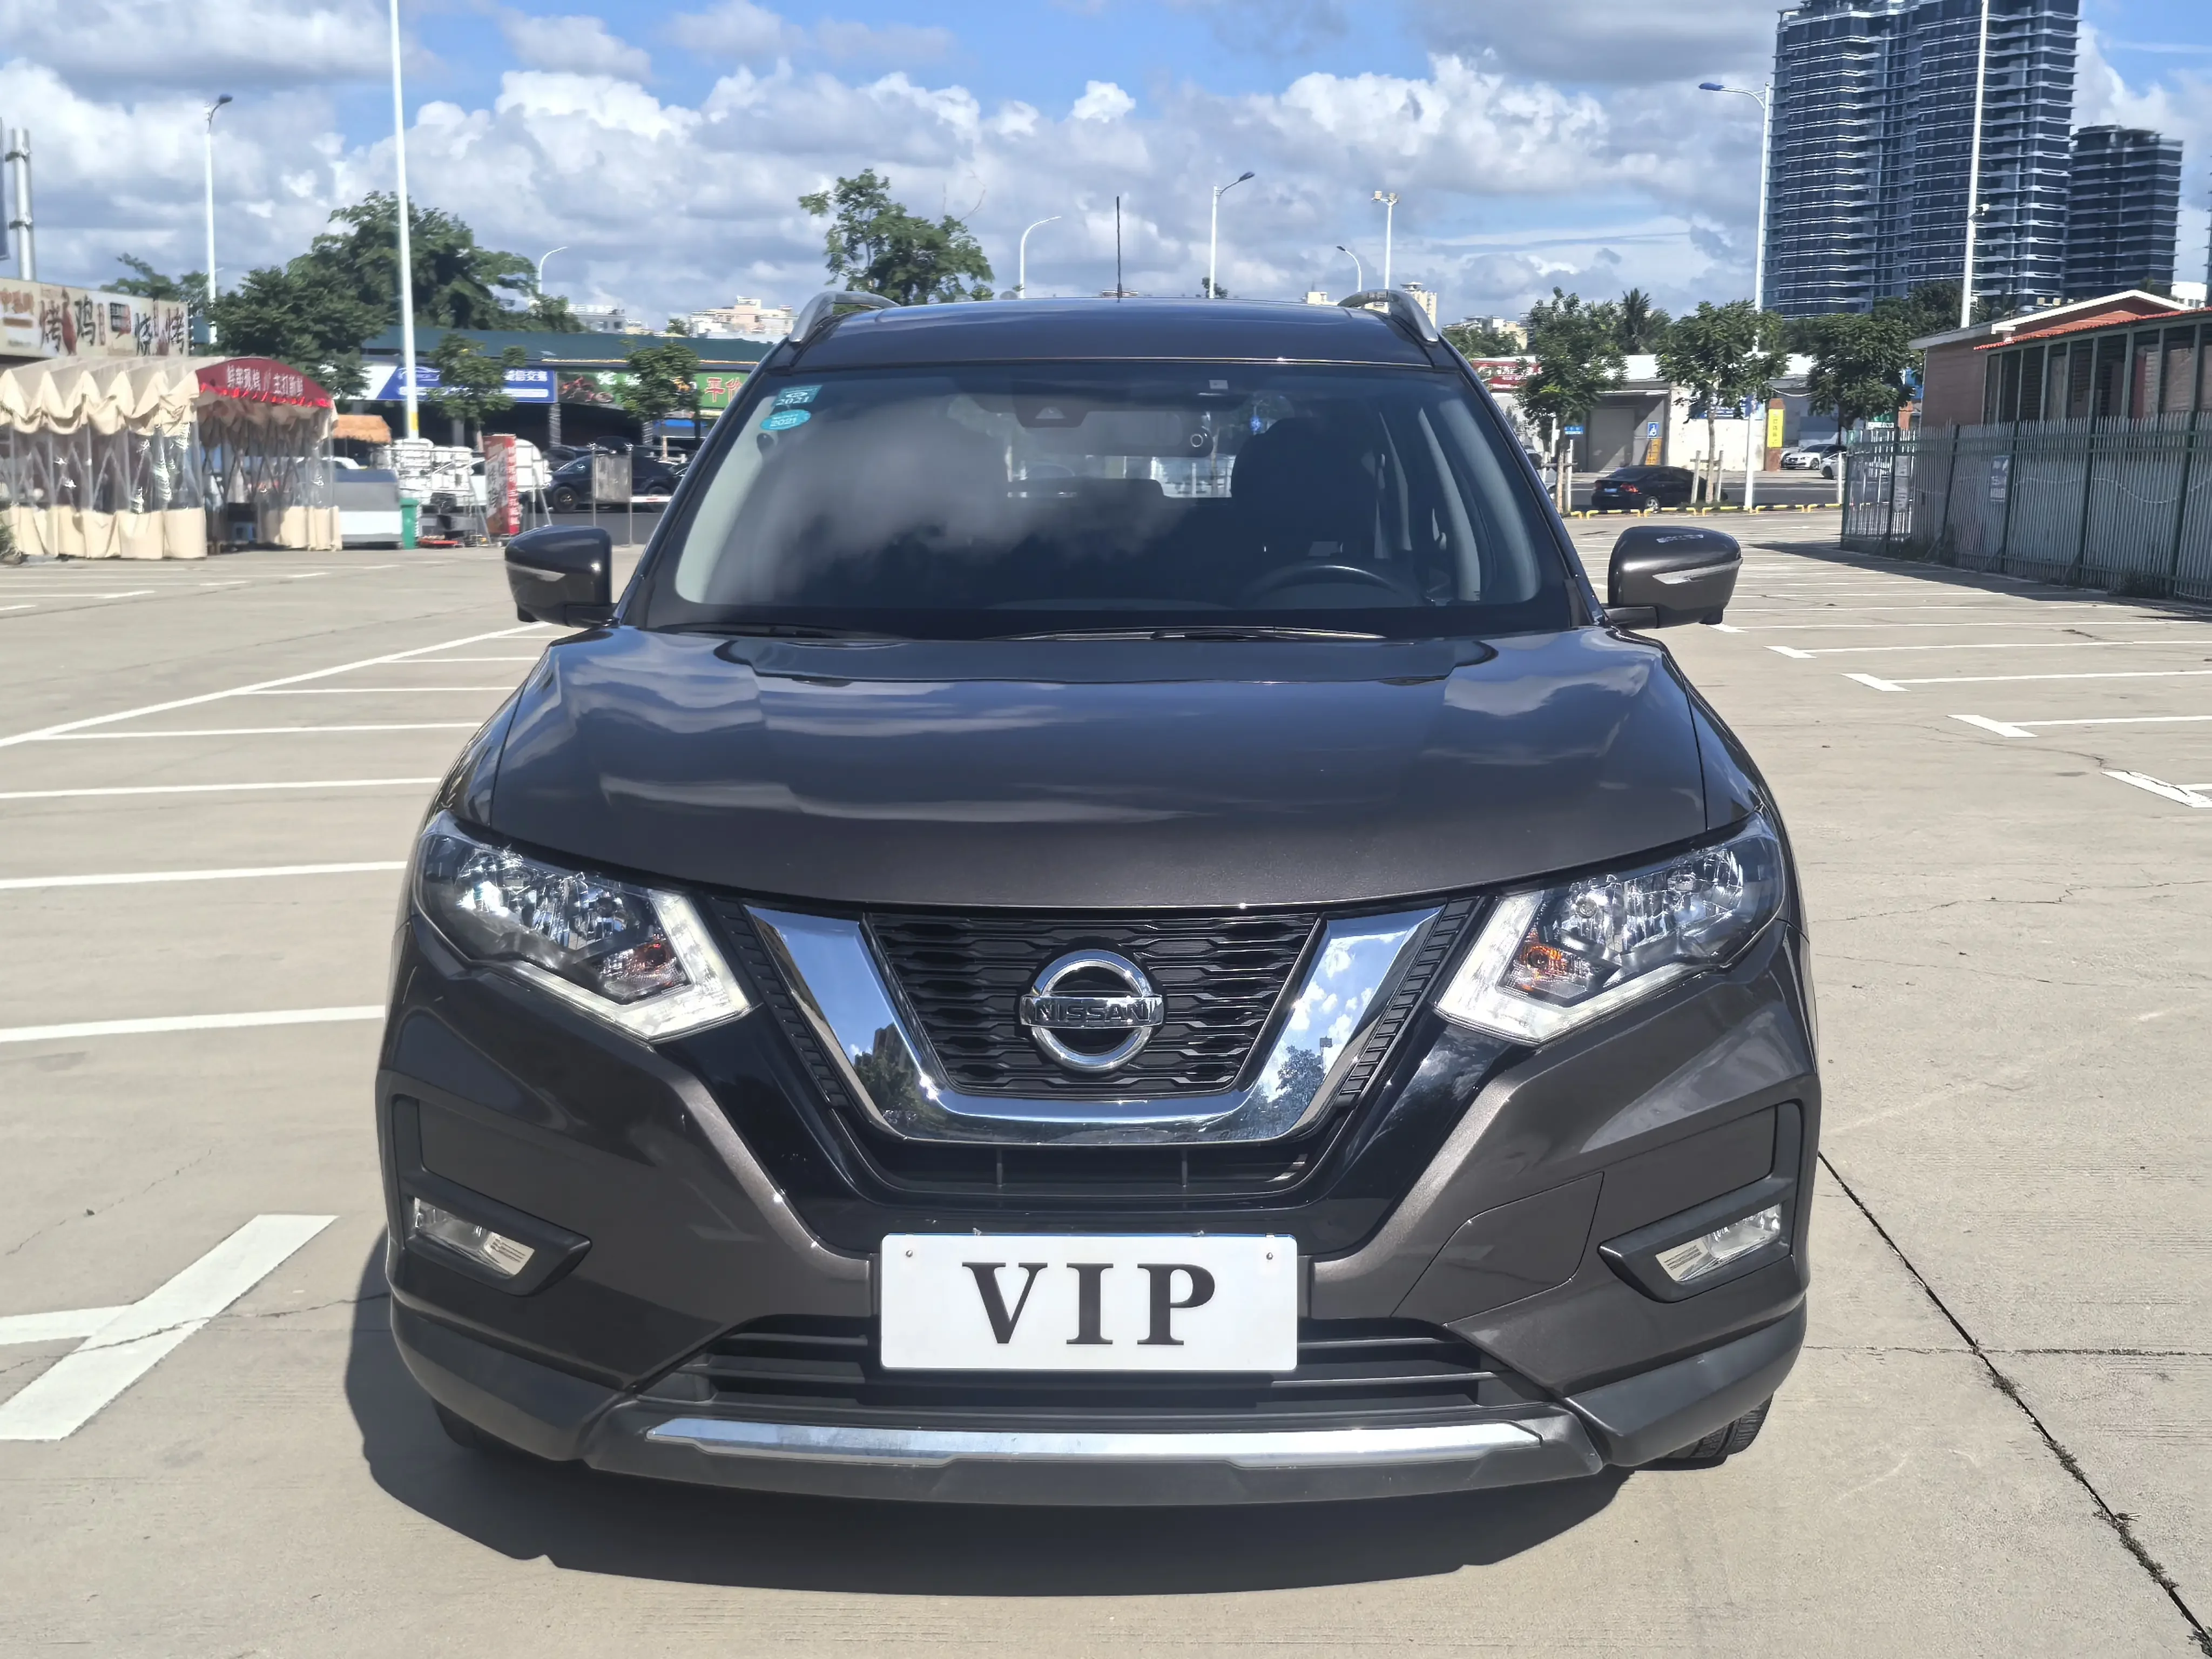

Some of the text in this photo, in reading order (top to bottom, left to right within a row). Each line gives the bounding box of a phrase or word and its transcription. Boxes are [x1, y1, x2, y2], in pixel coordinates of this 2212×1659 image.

[775, 396, 810, 406] 2021
[770, 417, 798, 427] 2021
[1035, 1002, 1151, 1022] NISSAN
[961, 1262, 1216, 1346] VIP
